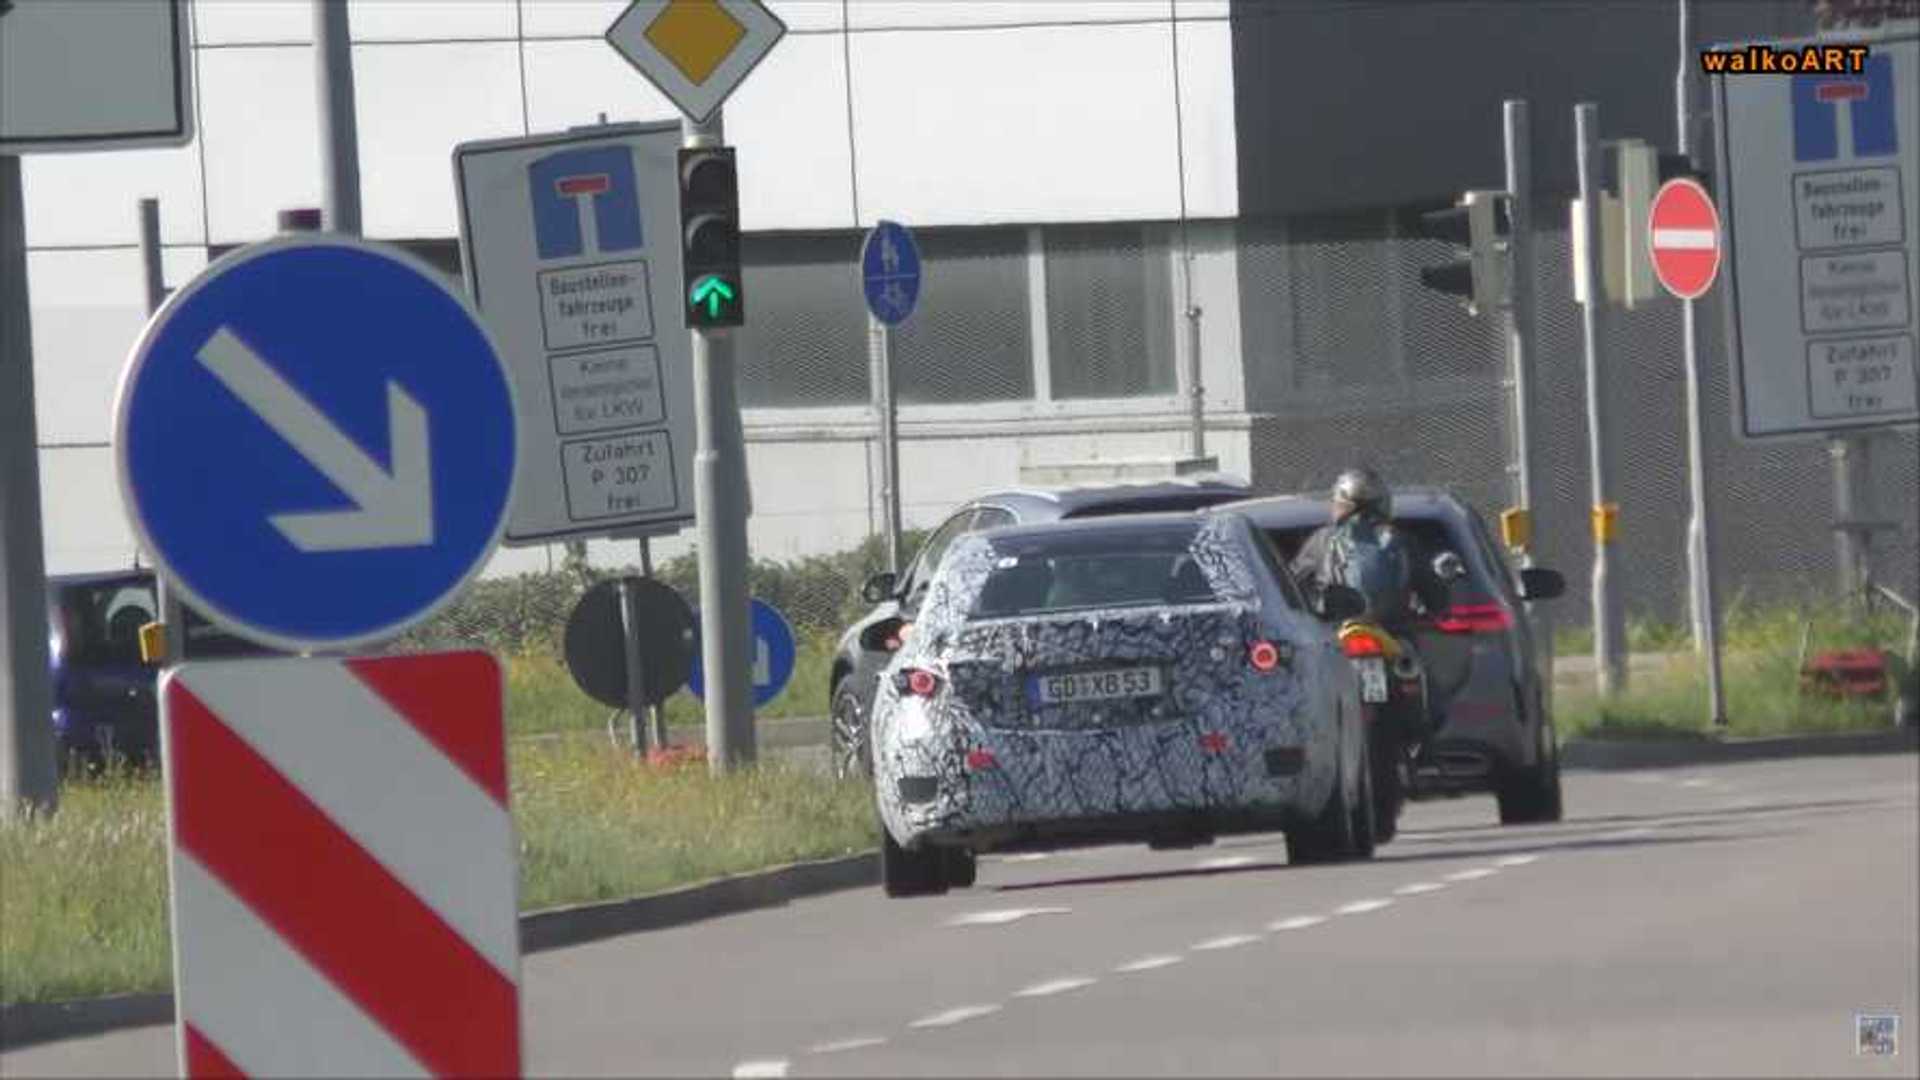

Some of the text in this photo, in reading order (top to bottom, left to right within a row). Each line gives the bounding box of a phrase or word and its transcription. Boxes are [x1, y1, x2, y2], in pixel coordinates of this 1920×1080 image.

[550, 273, 637, 295] Baustellen-
[558, 296, 634, 317] fahrzeuge
[582, 321, 617, 338] frei
[1826, 343, 1897, 364] Zufahrt
[583, 441, 655, 463] Zufahrt
[592, 464, 651, 485] P 307
[607, 492, 640, 510] frei
[1123, 671, 1150, 692] 53
